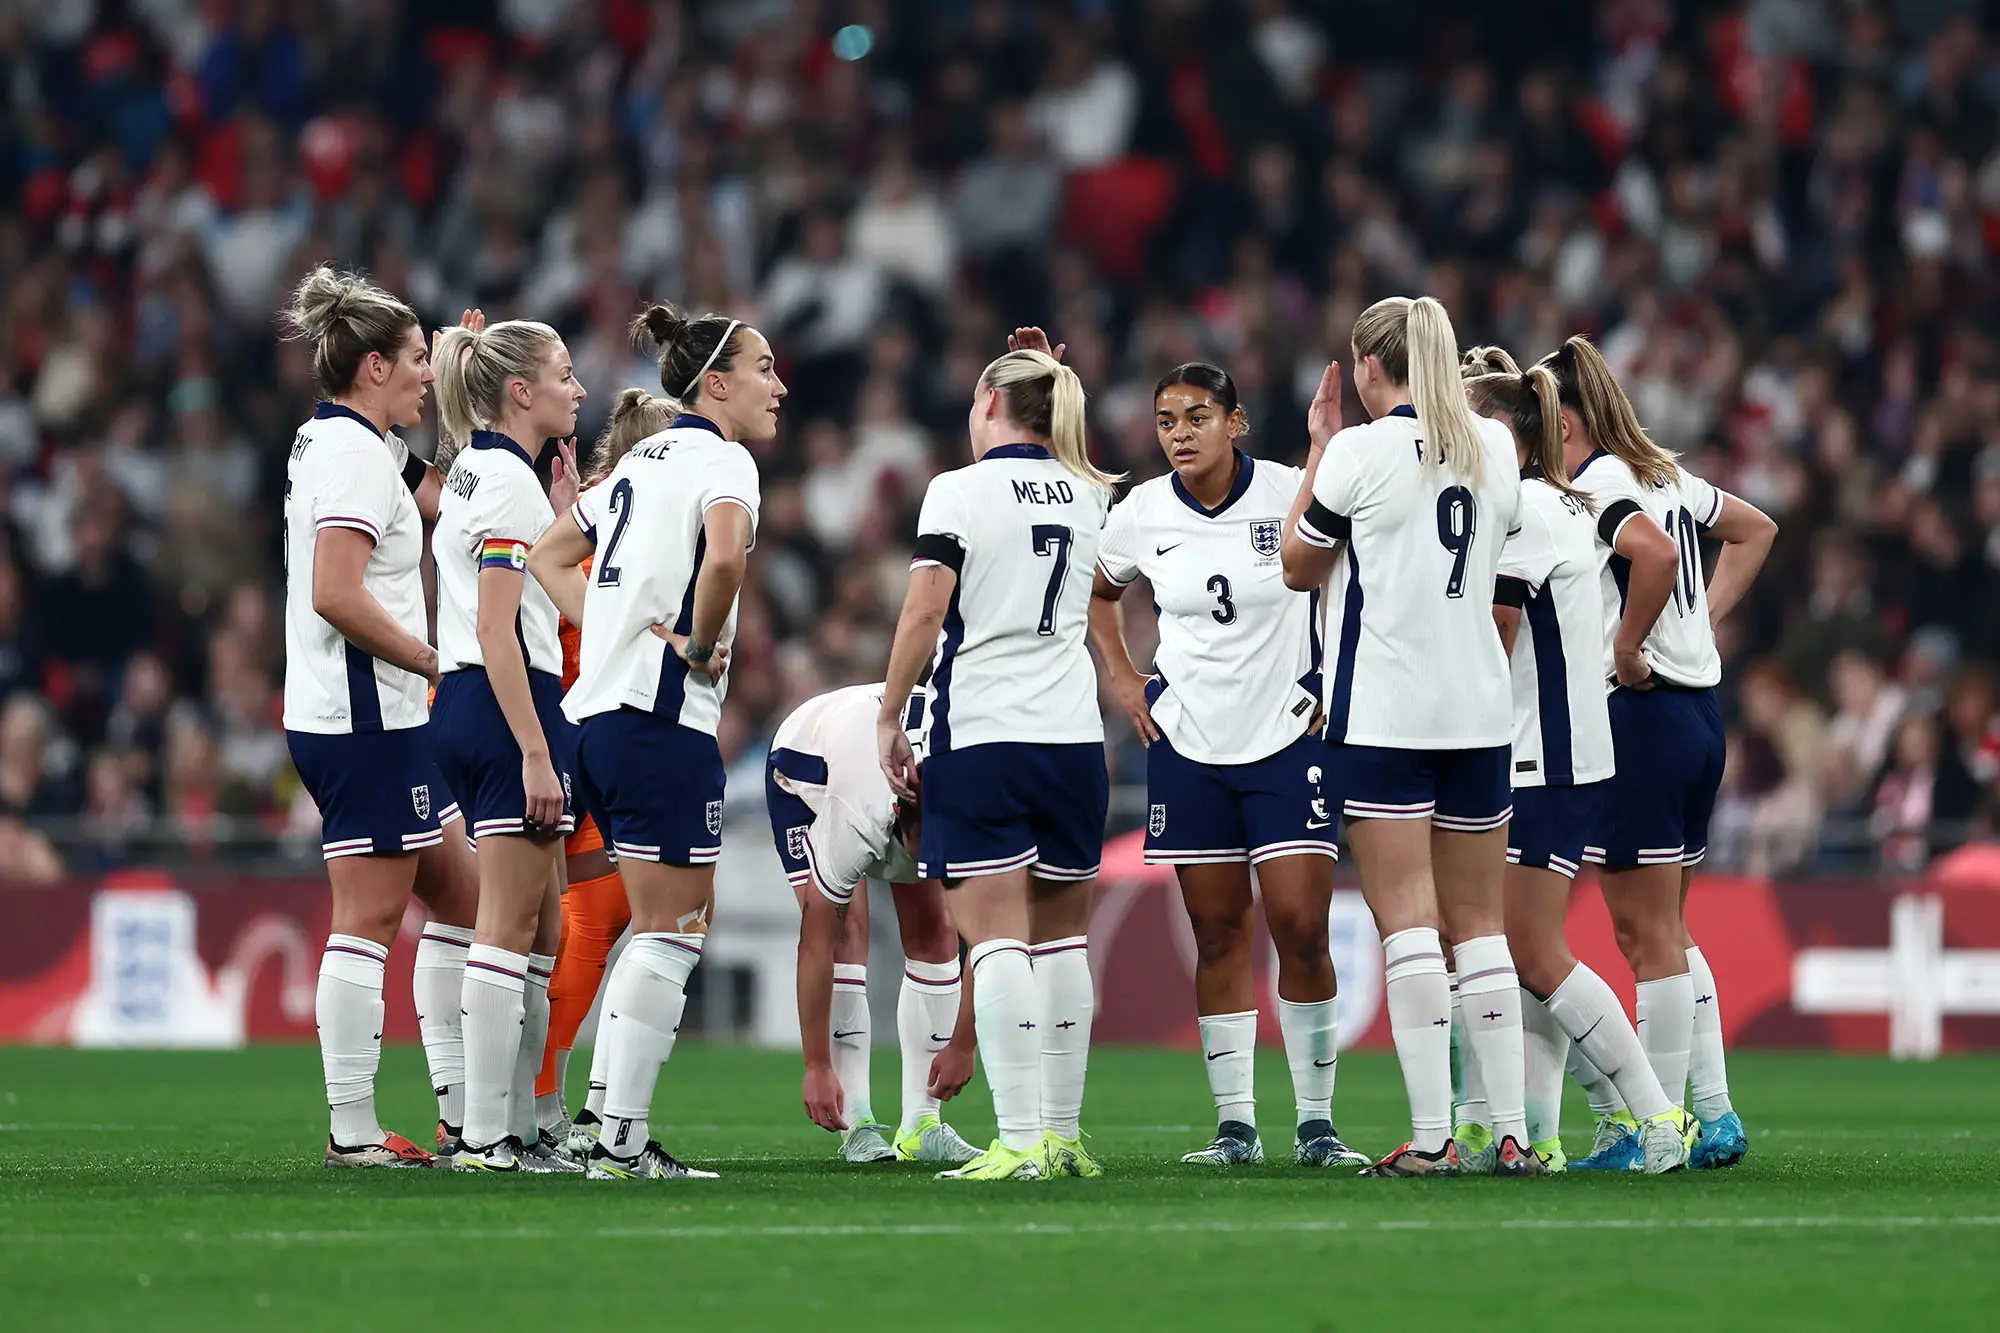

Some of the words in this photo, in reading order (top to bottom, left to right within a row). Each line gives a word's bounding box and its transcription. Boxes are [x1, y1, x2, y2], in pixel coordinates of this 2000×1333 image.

[597, 477, 635, 588] 2
[1011, 479, 1074, 505] MEAD
[1436, 485, 1477, 599] 9
[1031, 523, 1075, 636] 7
[1206, 573, 1238, 626] 3
